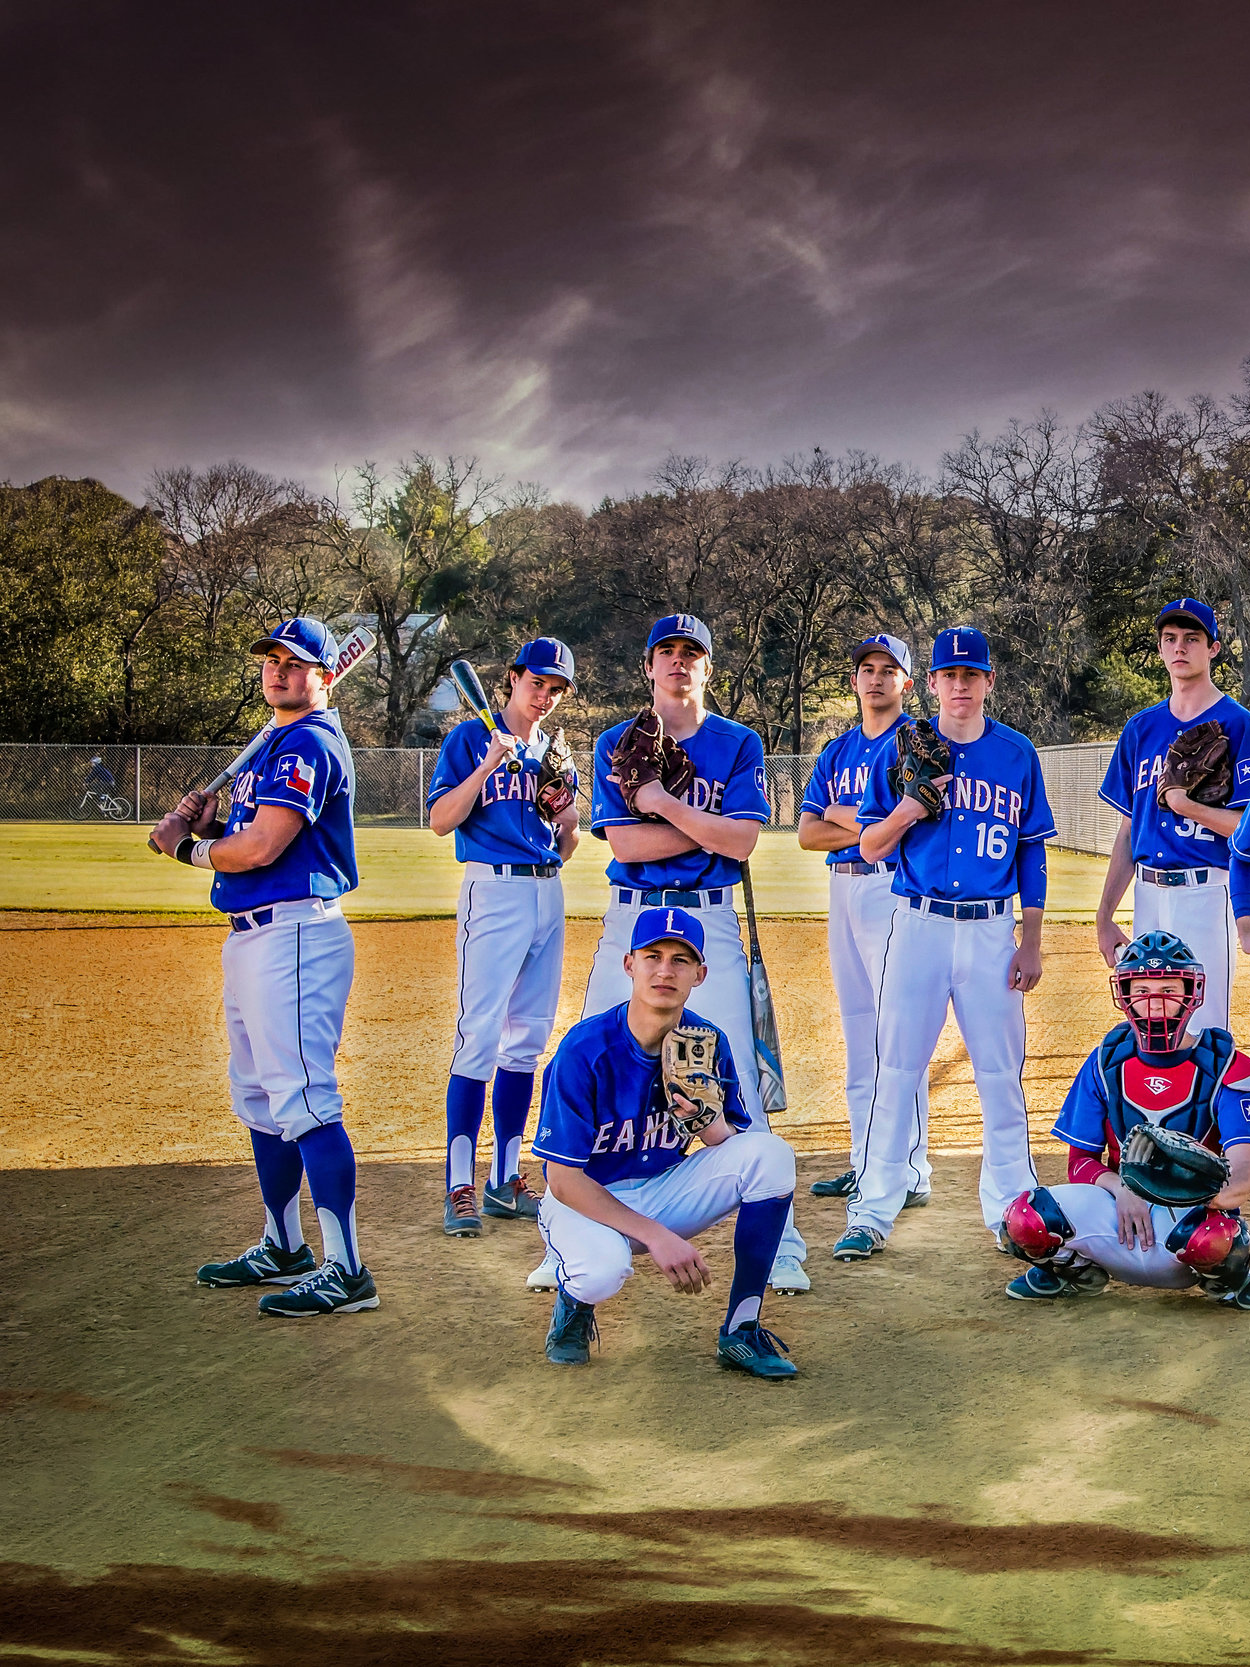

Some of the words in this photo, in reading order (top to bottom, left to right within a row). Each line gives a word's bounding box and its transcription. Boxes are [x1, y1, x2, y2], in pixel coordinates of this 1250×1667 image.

[279, 619, 296, 638] L
[677, 614, 693, 632] L
[953, 634, 968, 656] L
[554, 645, 567, 668] L
[976, 822, 1010, 860] 16
[665, 910, 684, 935] L
